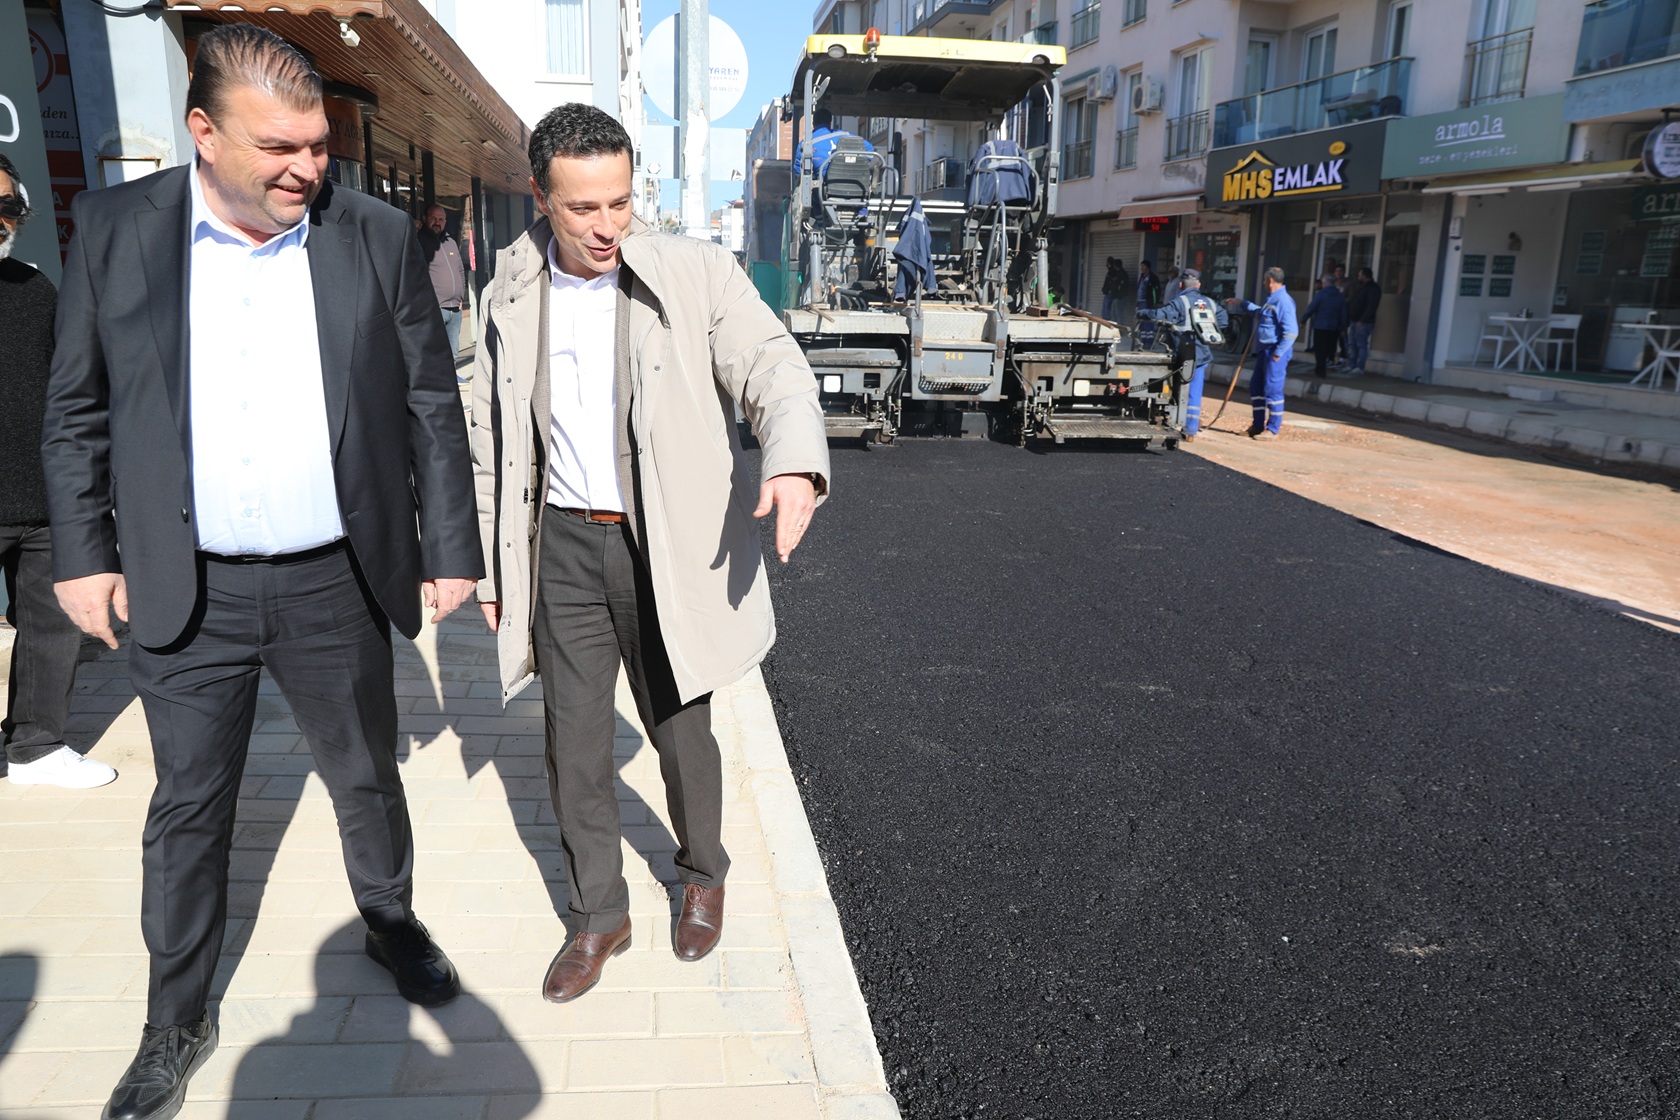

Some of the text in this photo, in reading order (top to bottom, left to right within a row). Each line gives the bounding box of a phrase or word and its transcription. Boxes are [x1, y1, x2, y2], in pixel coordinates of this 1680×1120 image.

[708, 67, 739, 75] YAREN
[1434, 114, 1503, 141] armola
[1222, 158, 1344, 202] MHS EMLAK
